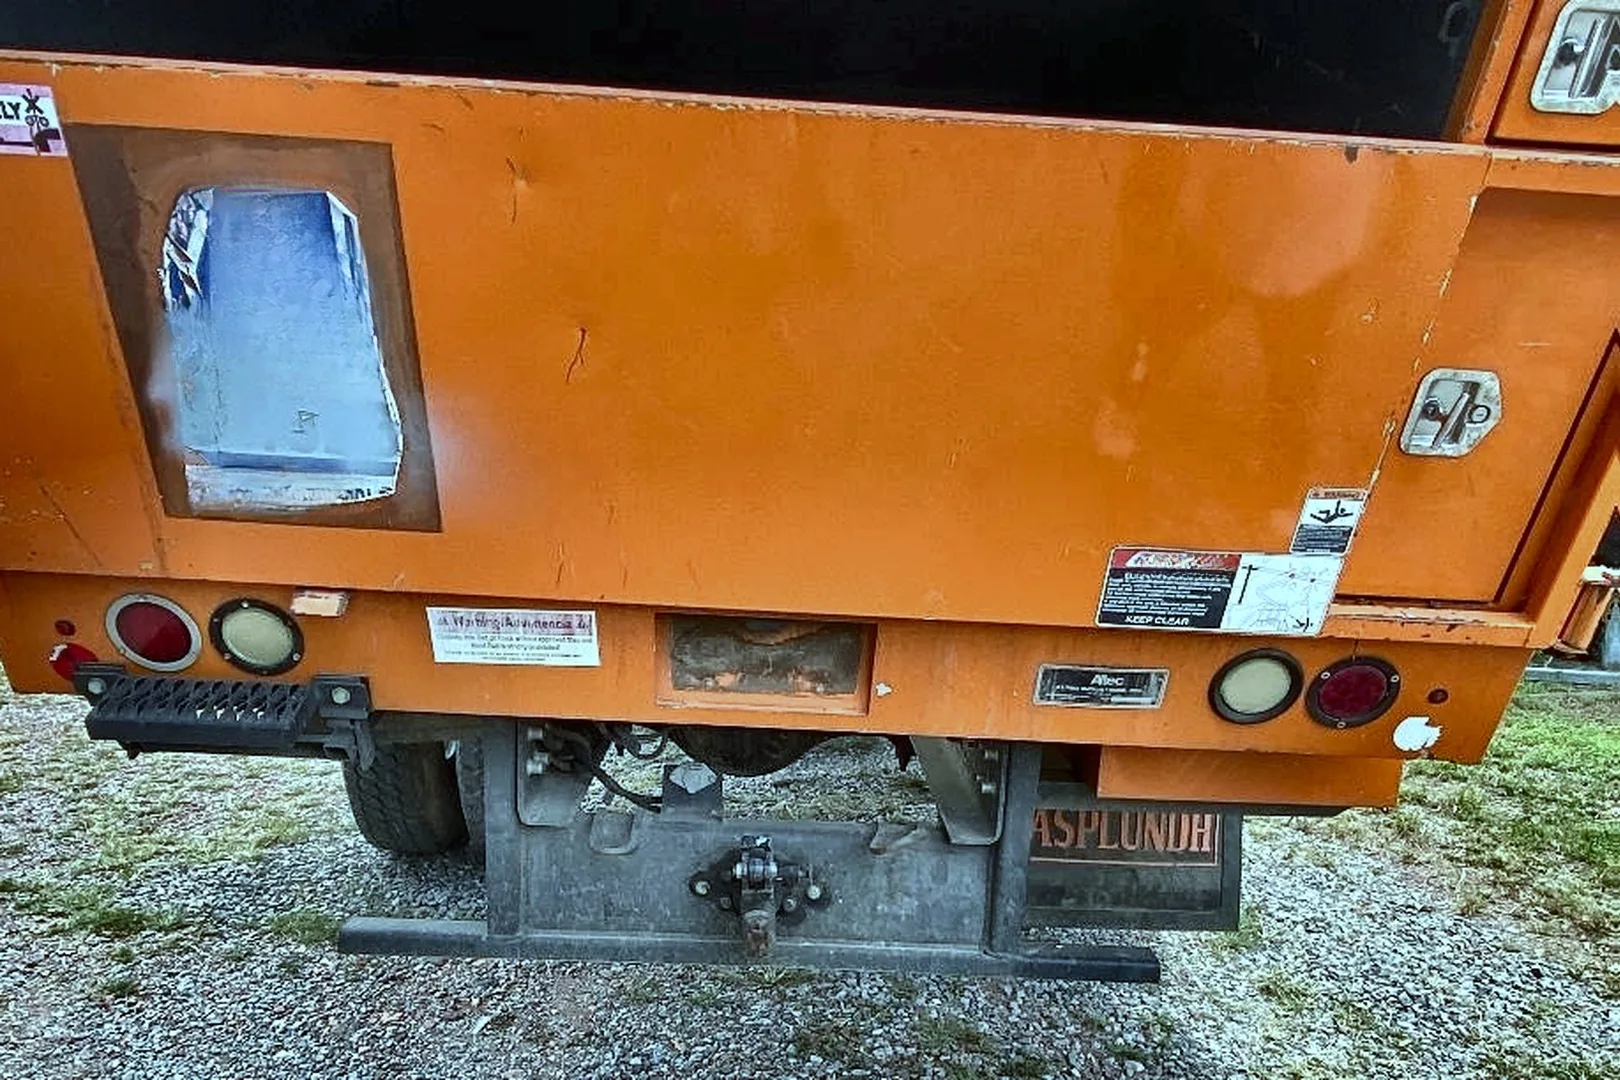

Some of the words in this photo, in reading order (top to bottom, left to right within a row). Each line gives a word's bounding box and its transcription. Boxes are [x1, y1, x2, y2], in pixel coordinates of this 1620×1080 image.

[0, 100, 21, 120] LY
[1124, 615, 1153, 624] KEEP
[1154, 617, 1189, 626] CLEAR
[1034, 810, 1211, 851] ASPLUNDH
